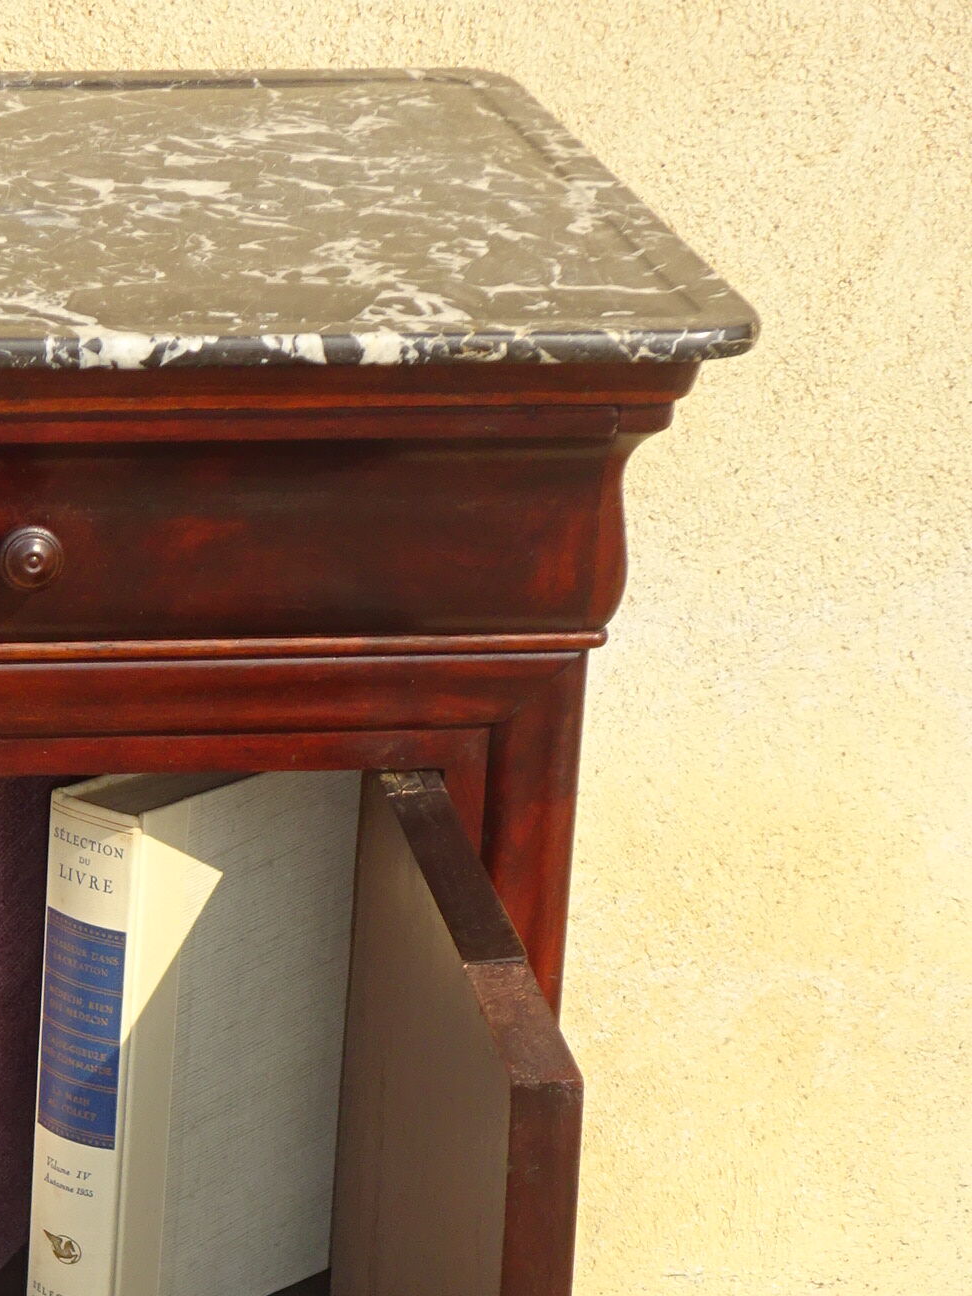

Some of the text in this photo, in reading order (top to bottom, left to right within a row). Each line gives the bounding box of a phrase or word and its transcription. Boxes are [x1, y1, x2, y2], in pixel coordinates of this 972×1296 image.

[53, 826, 124, 860] SÉLECTION
[79, 856, 91, 866] DU
[59, 862, 114, 894] LIVRE
[47, 1156, 92, 1181] Volume IV
[44, 1172, 94, 1198] Automne 1955
